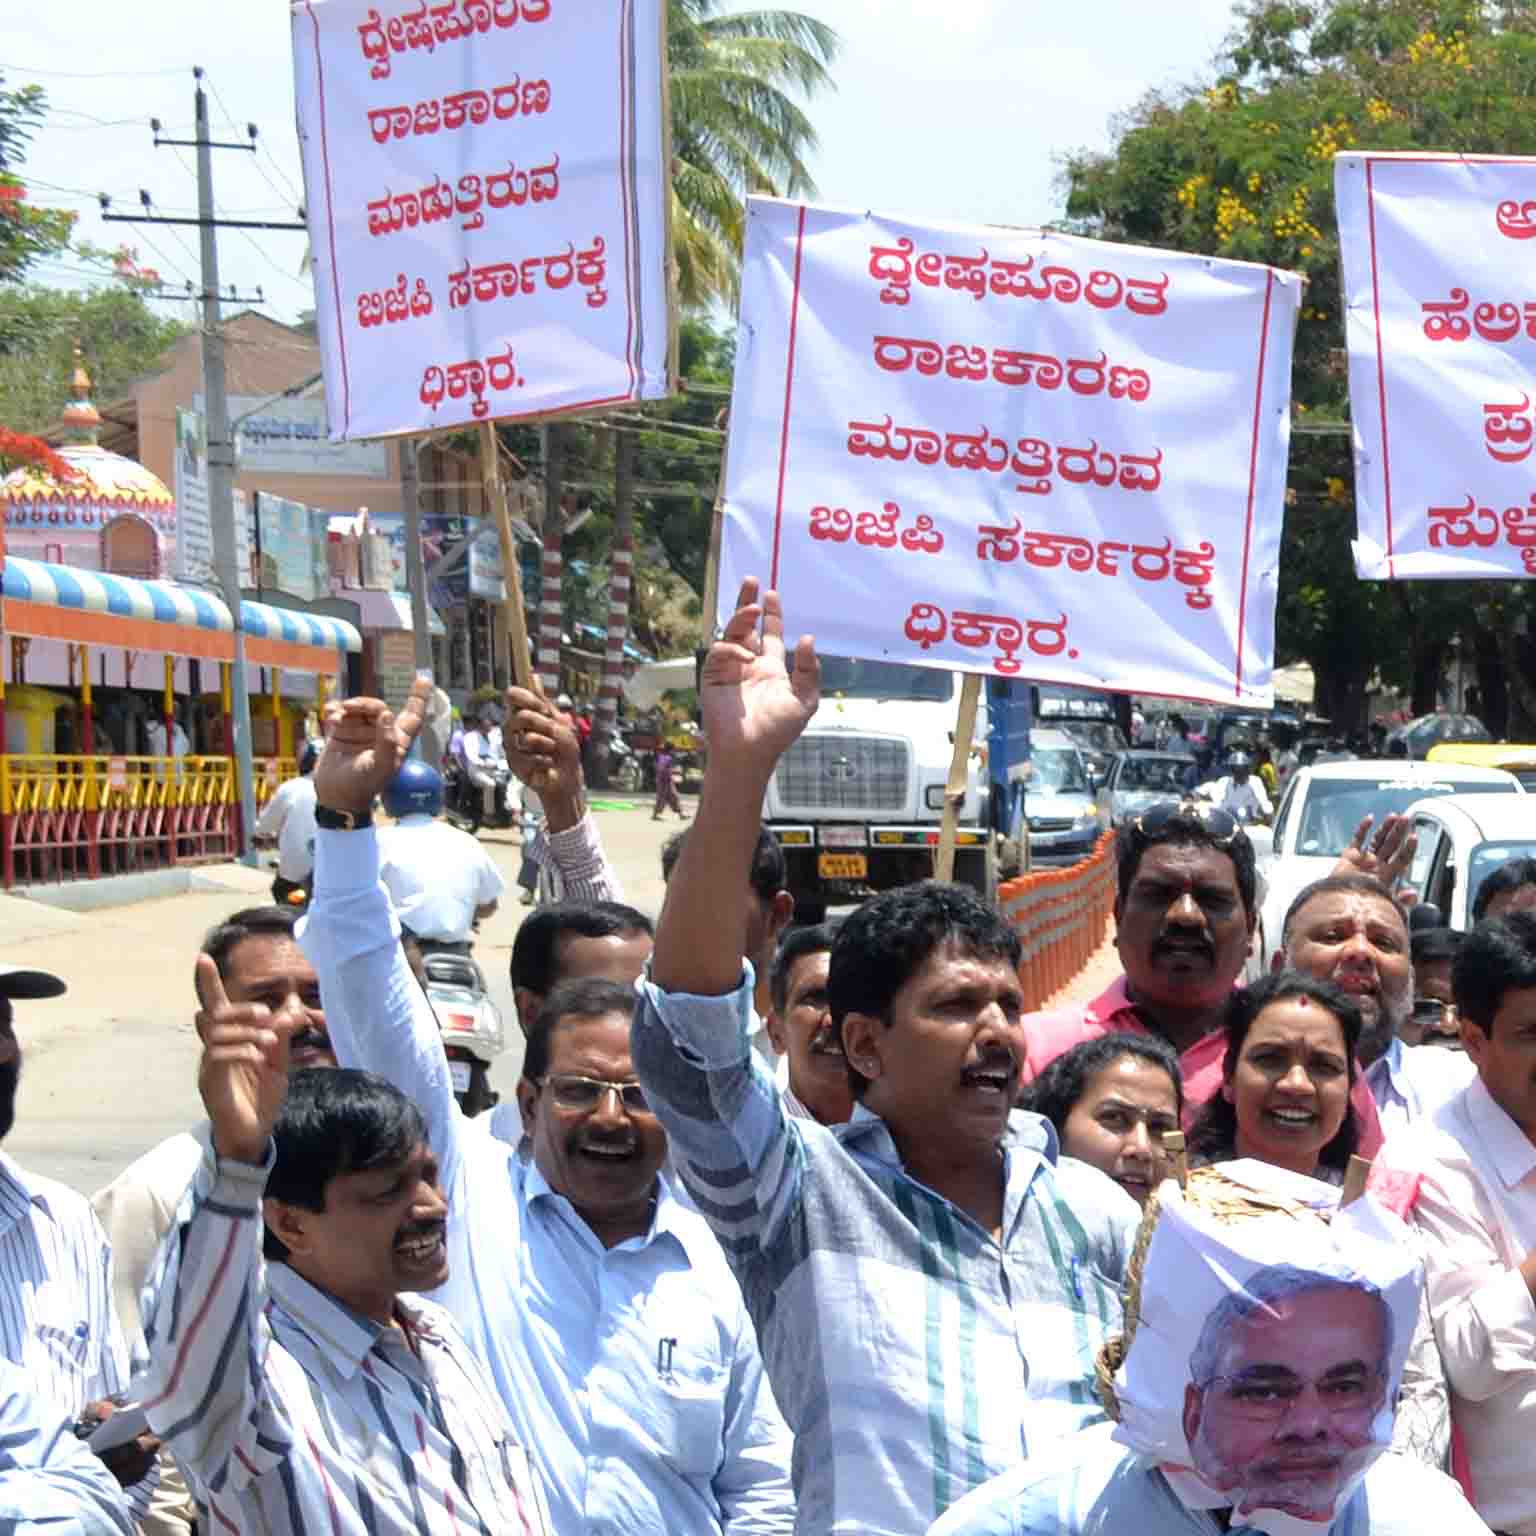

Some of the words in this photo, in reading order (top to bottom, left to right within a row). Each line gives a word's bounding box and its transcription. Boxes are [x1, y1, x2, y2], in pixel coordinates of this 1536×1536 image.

[368, 72, 550, 143] ರಾಜಕಾರಣ
[367, 154, 560, 236] ಮಾಡುತ್ತಿರುವ
[357, 273, 433, 328] ಬಿಜೆಪಿ
[448, 237, 607, 308] ಸರ್ಕಾರಕ್ಕೆ
[870, 239, 1168, 315] ದ್ವೇಷಪೂರಿತ
[420, 343, 525, 417] ಧಿಕ್ಕಾರ.
[875, 336, 1150, 400] ರಾಜಕಾರಣ
[848, 421, 1162, 494] ಮಾಡುತ್ತಿರುವ
[810, 504, 944, 552] ಬಿಜೆಪಿ
[978, 527, 1214, 608] ಸರ್ಕಾರಕ್ಕೆ
[905, 604, 1078, 674] ಧಿಕ್ಕಾರ.
